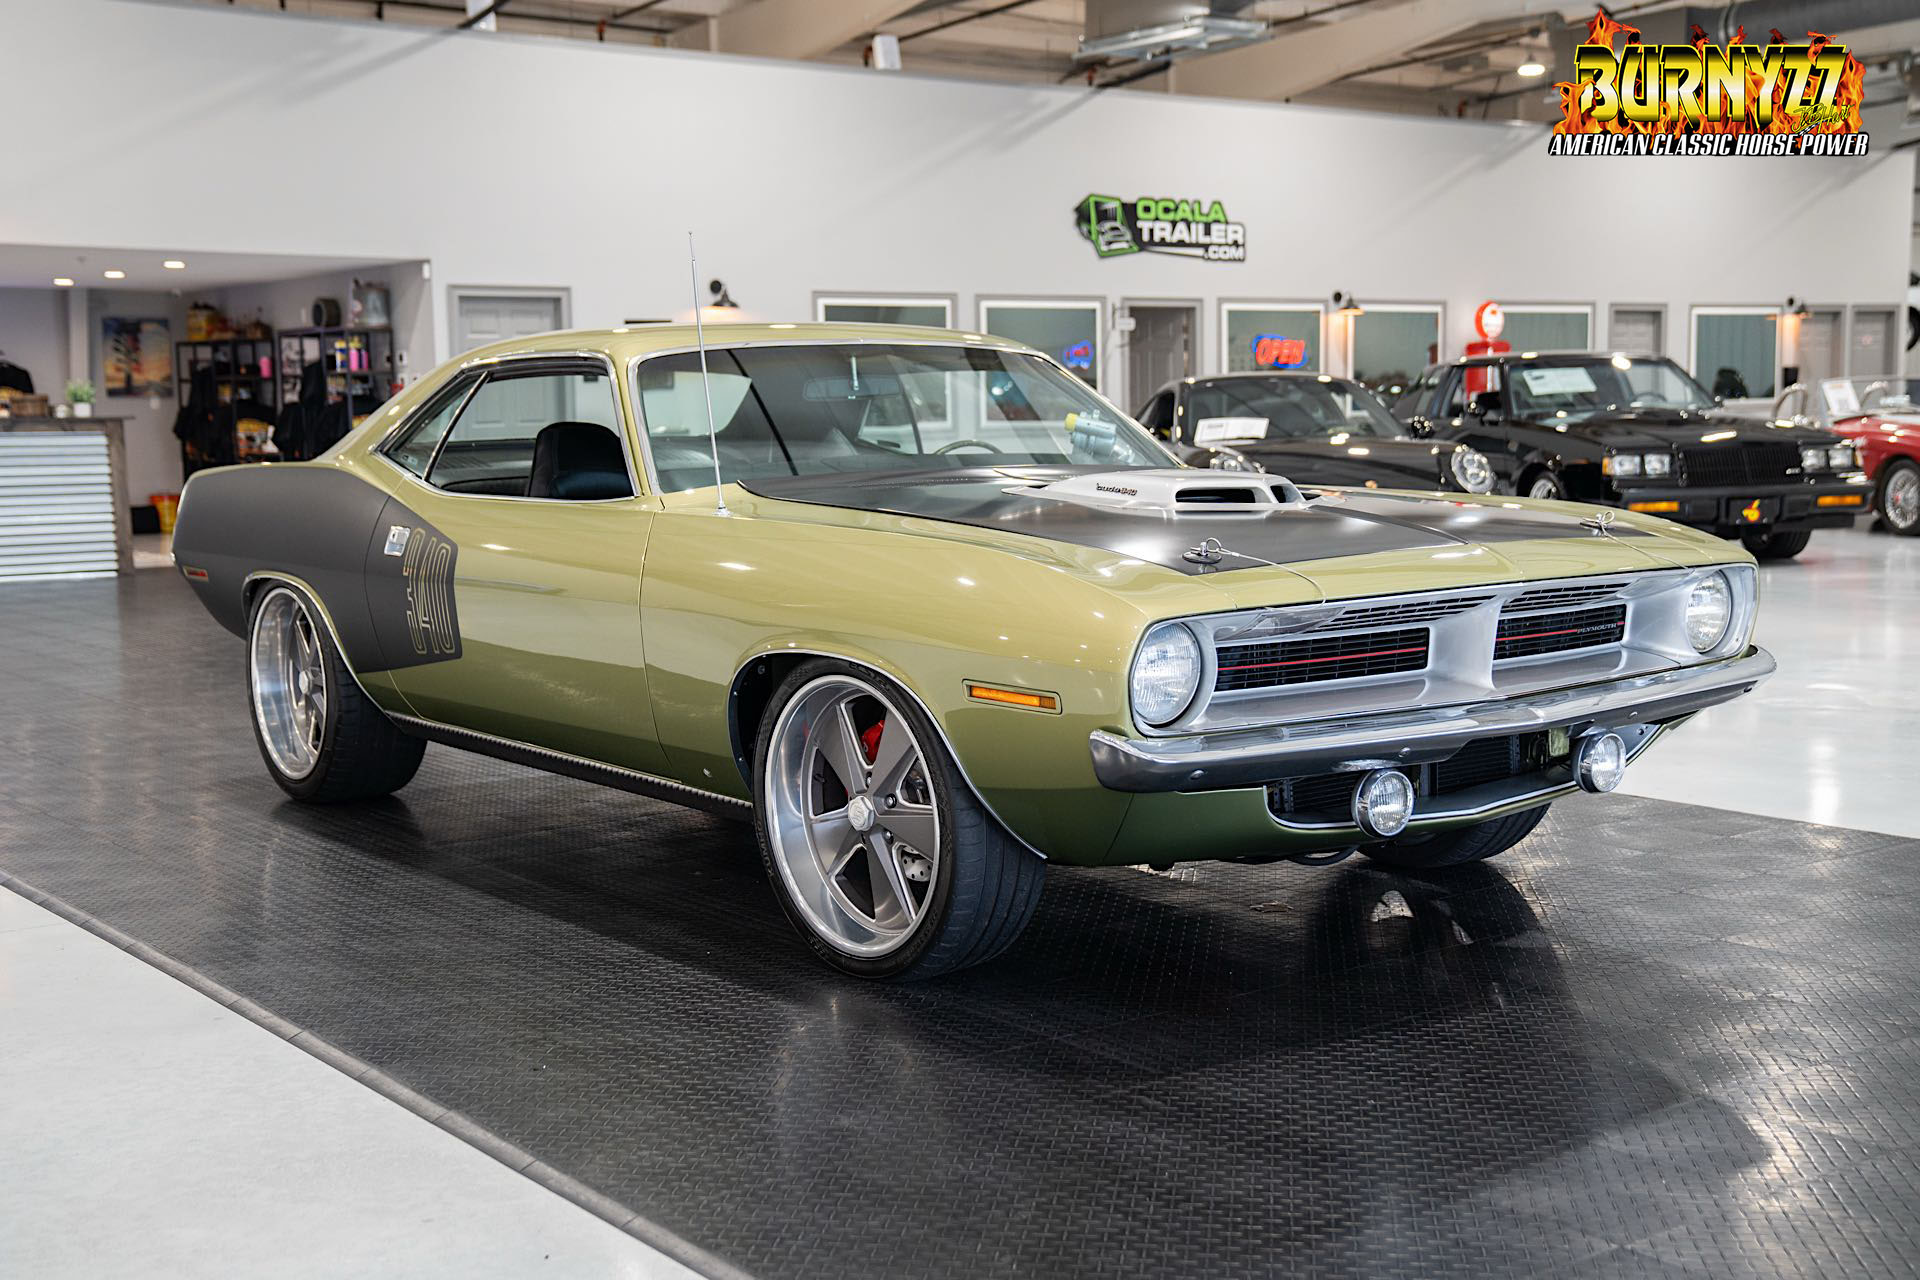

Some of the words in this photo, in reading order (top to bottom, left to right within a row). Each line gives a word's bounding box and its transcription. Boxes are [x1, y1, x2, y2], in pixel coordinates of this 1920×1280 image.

[1136, 197, 1228, 223] OCALA
[1136, 220, 1245, 245] TRAILER
[1204, 245, 1245, 261] .COM
[1255, 338, 1305, 365] OPEN
[1577, 623, 1617, 633] PLYMOUTH
